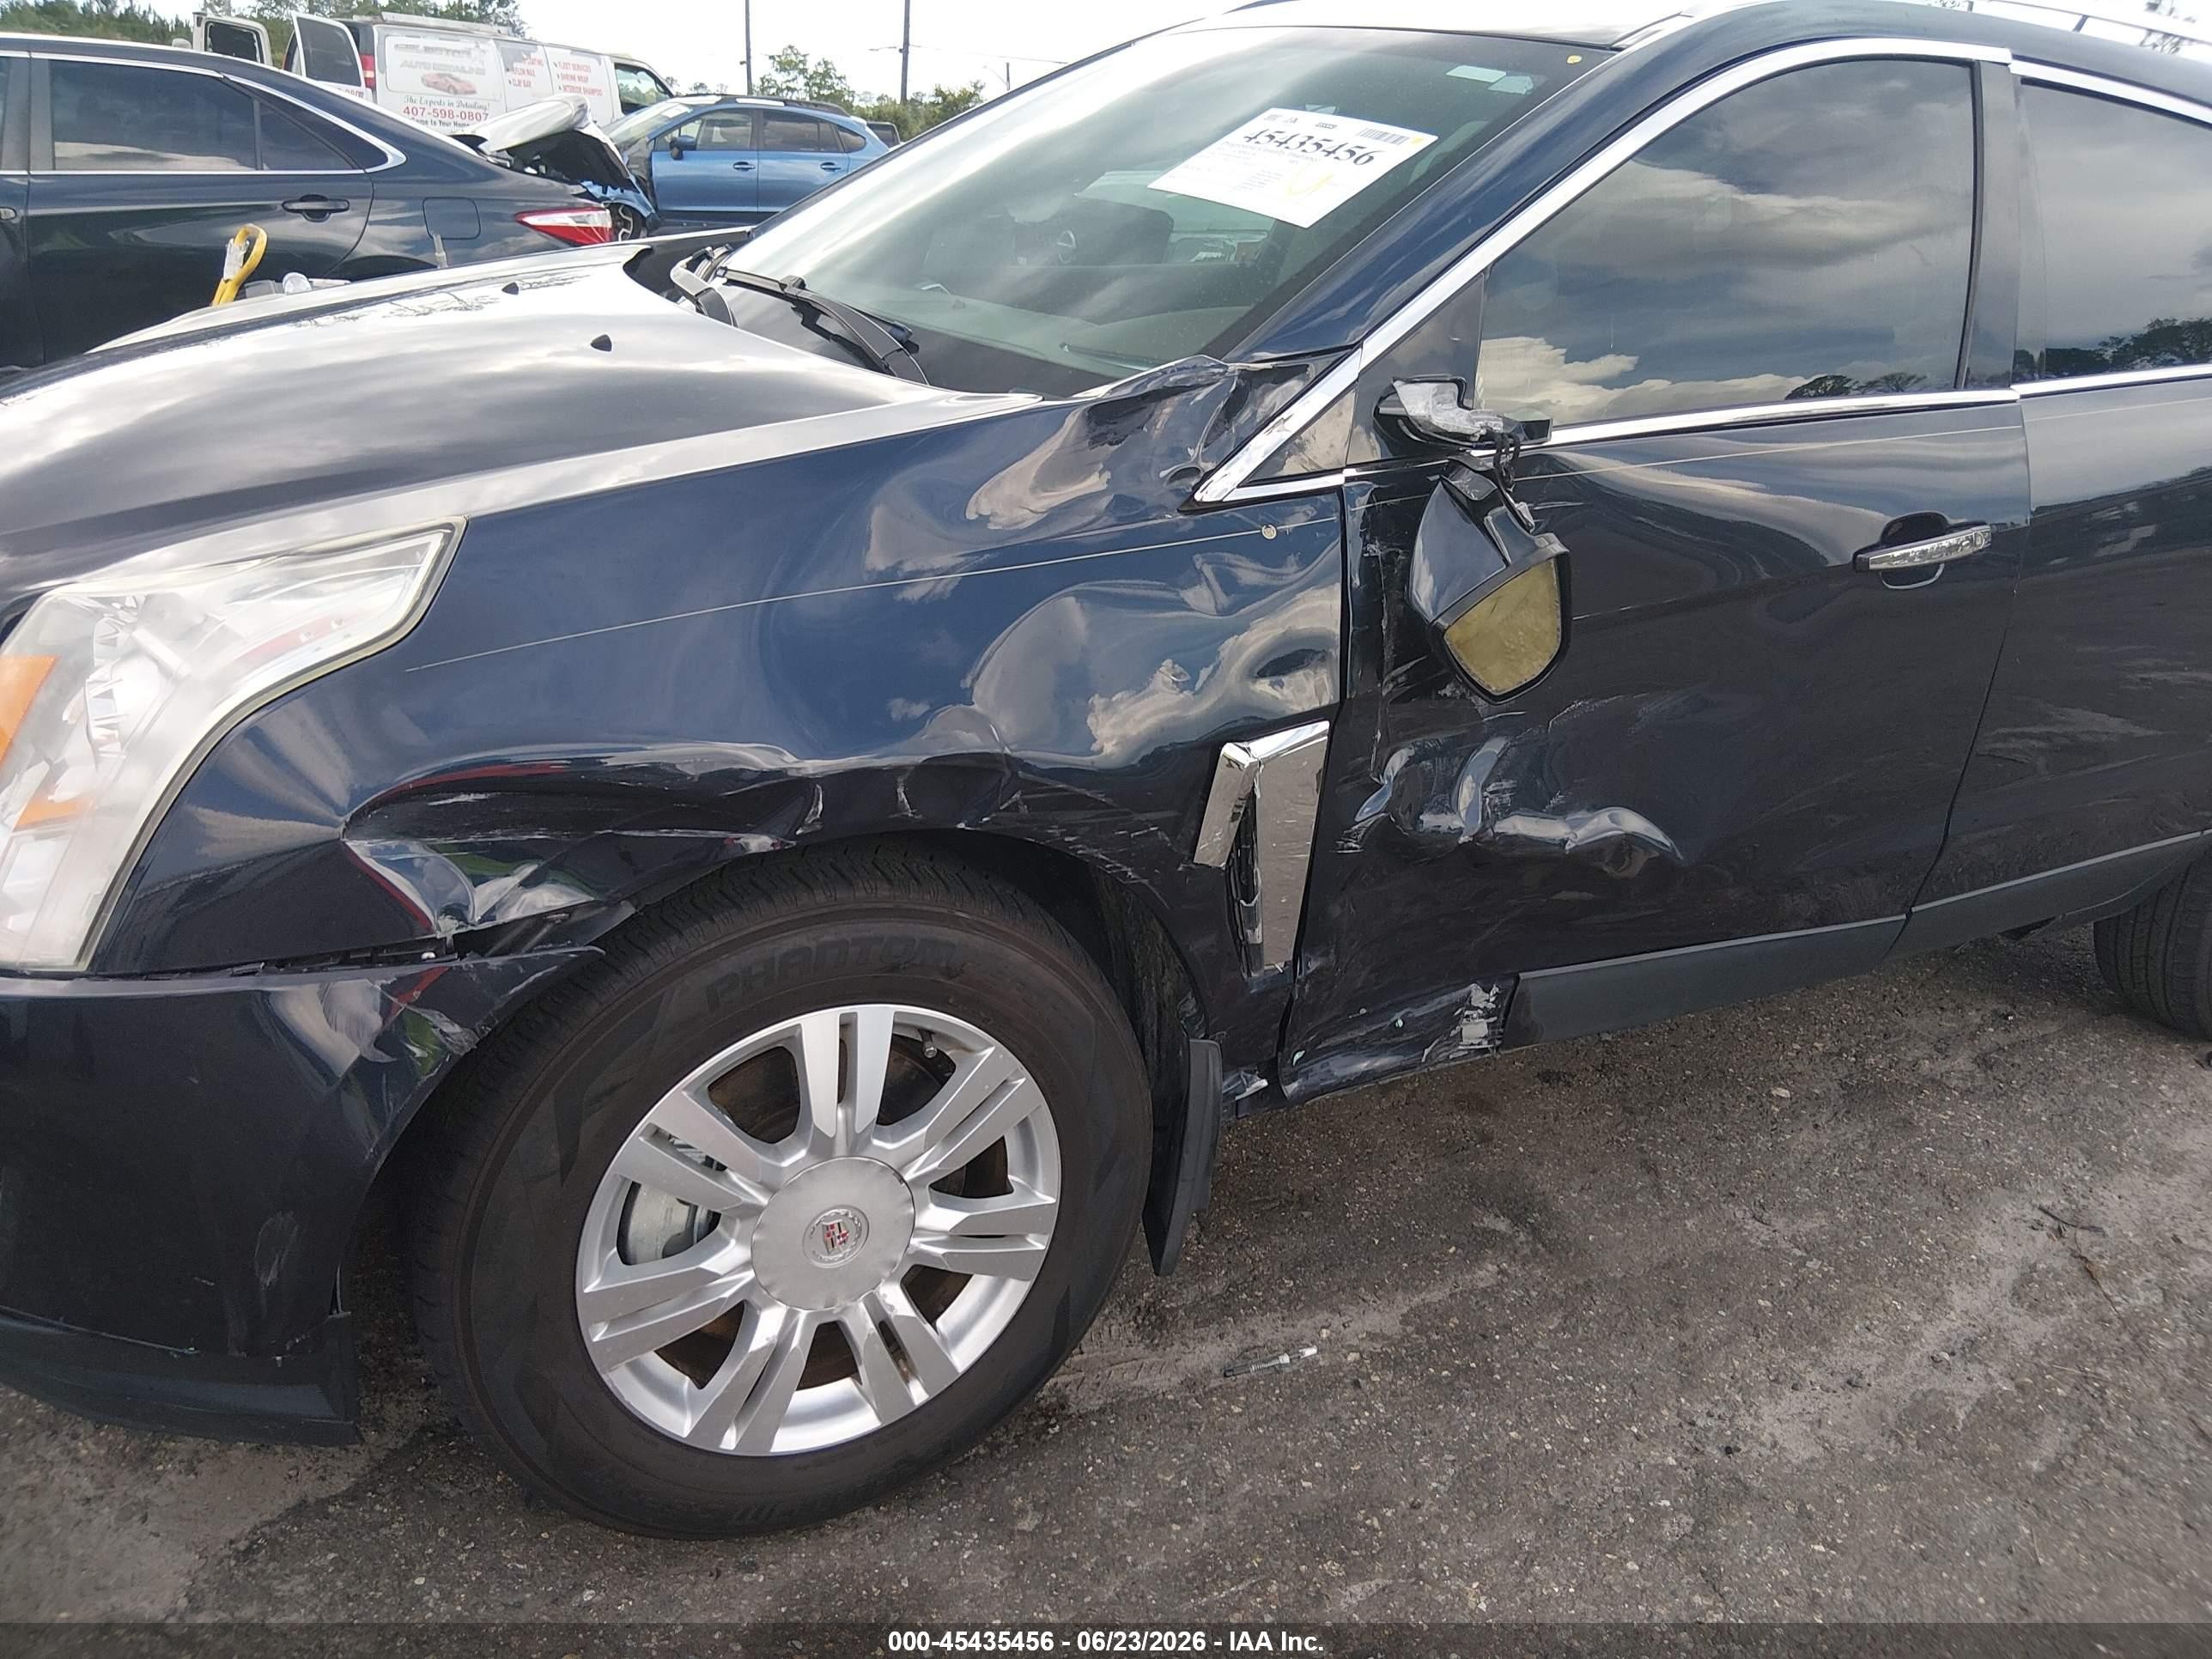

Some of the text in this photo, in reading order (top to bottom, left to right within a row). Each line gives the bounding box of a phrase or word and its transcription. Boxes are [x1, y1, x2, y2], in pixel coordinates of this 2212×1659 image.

[404, 95, 416, 104] The
[418, 96, 446, 107] Experts
[447, 99, 454, 107] in
[403, 105, 489, 122] 407-598-0807
[1243, 128, 1386, 167] 45435456
